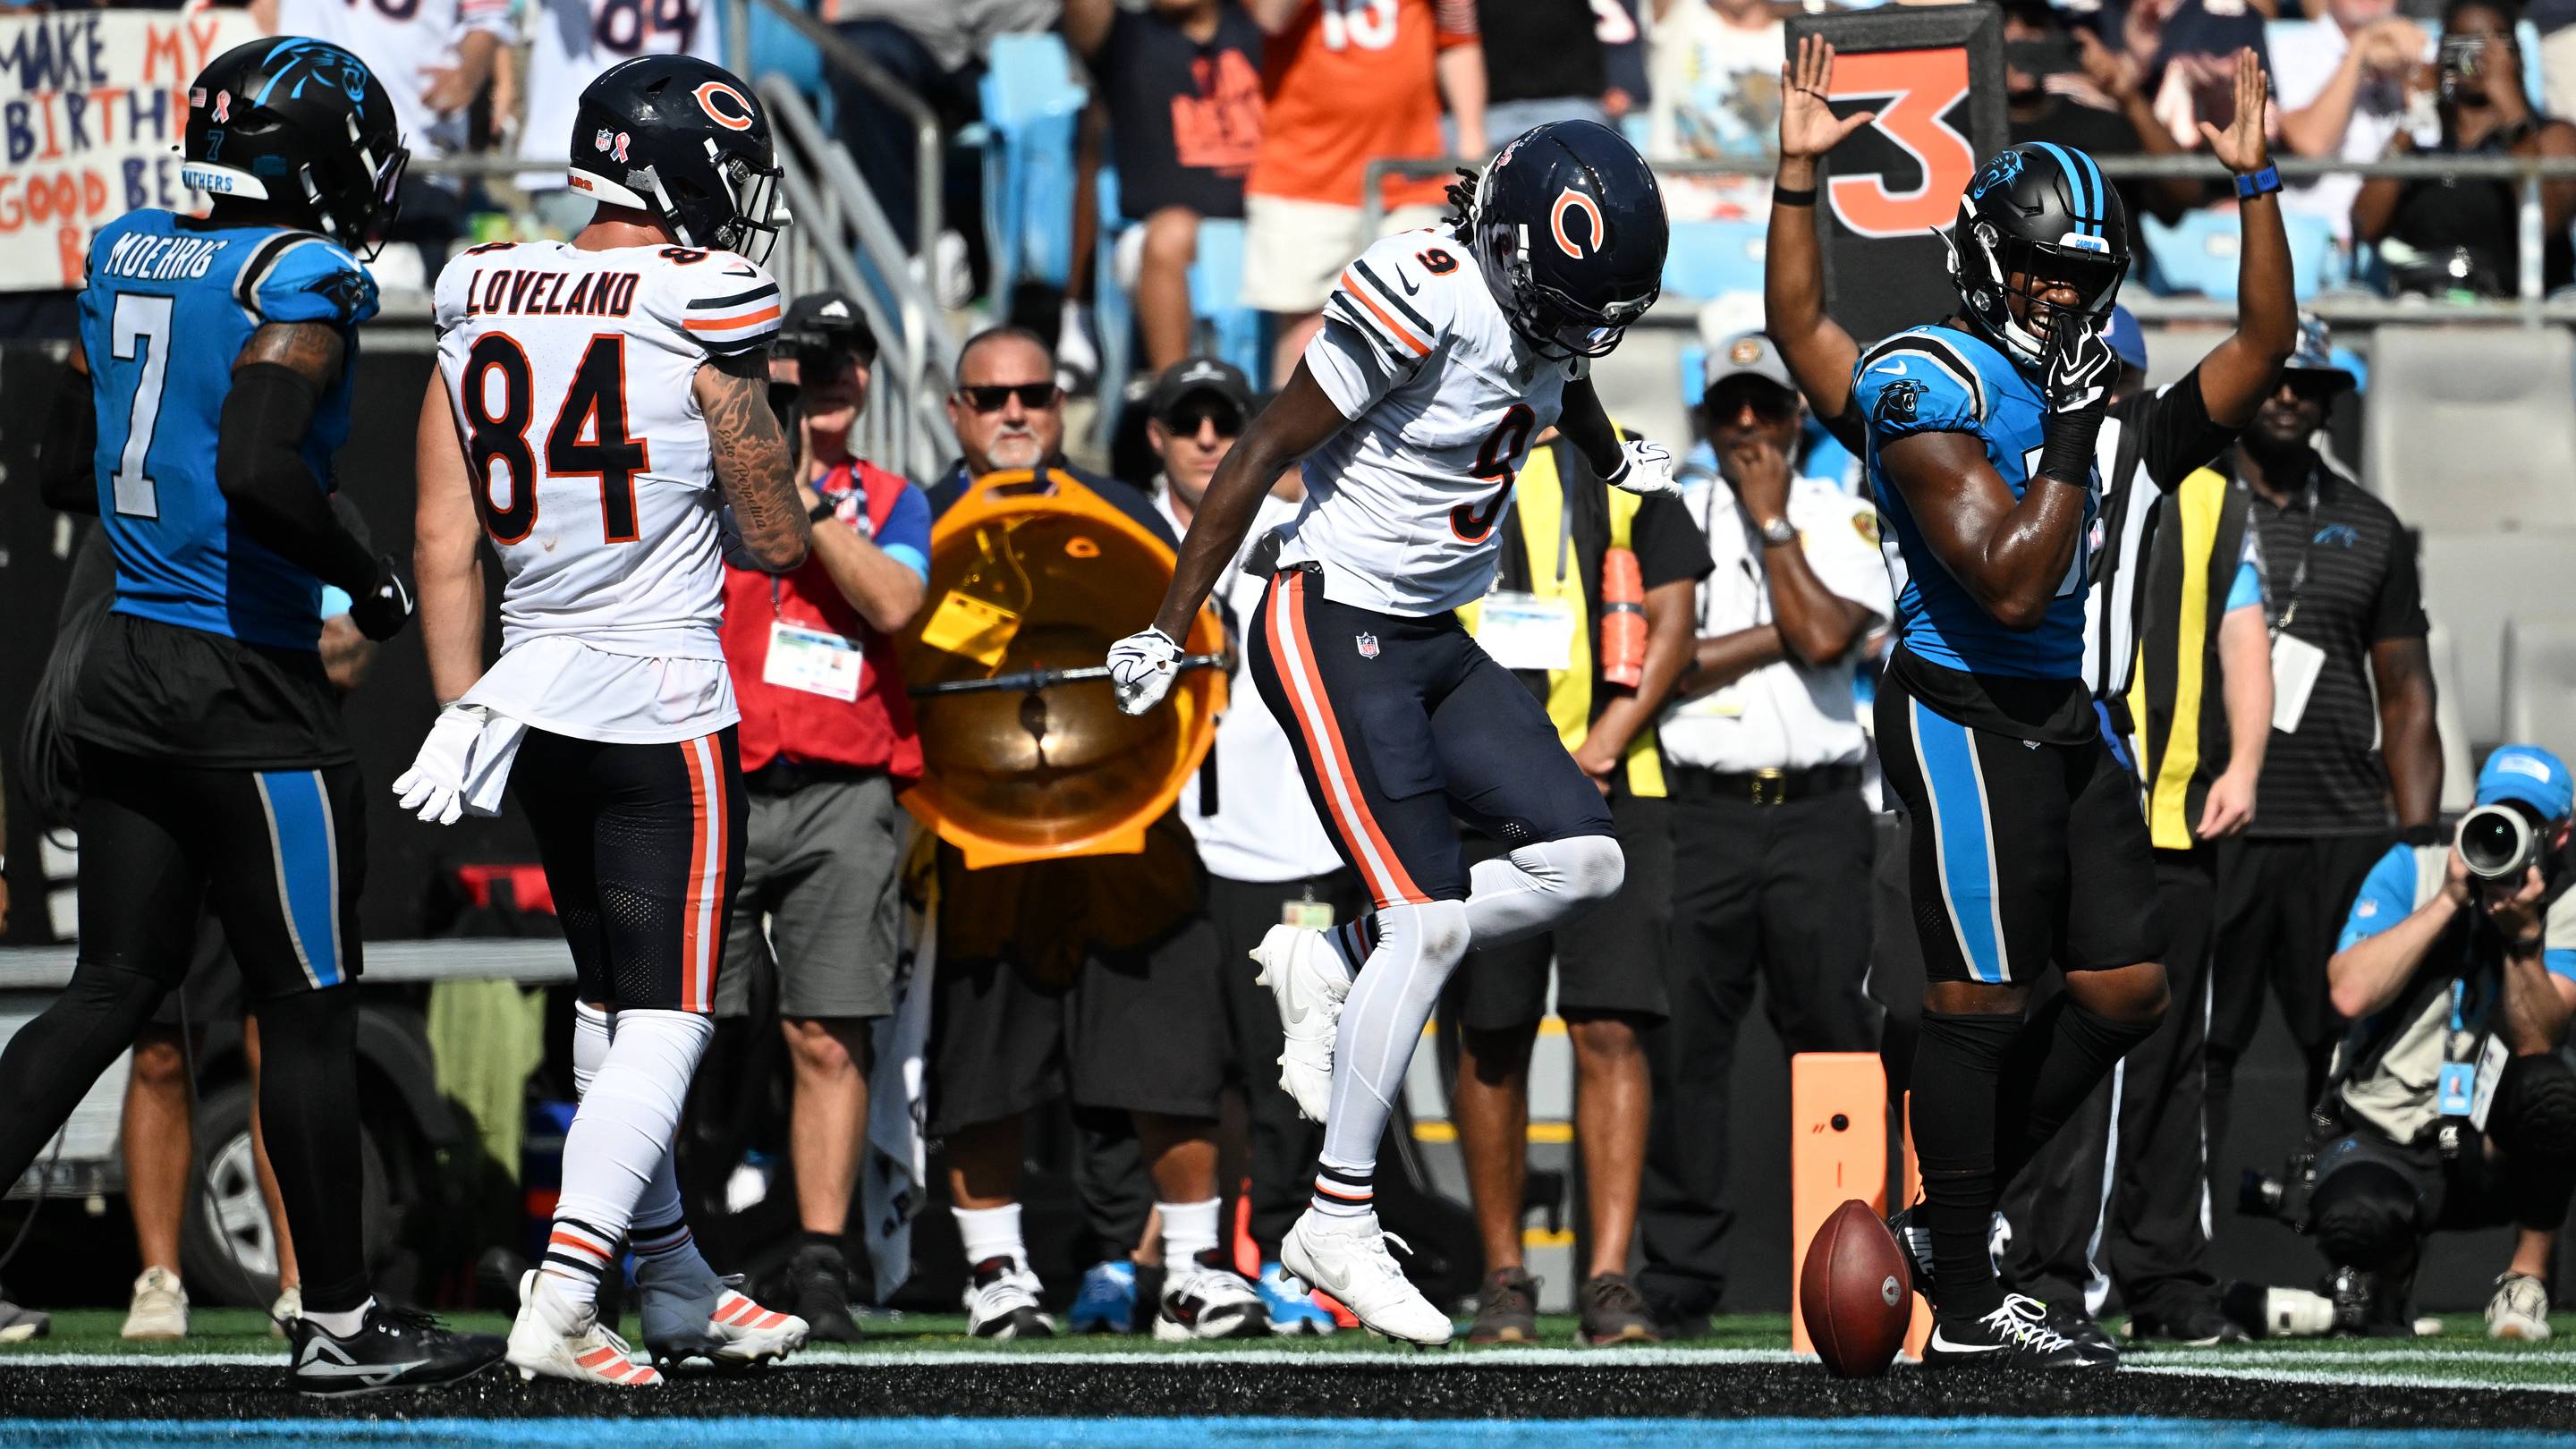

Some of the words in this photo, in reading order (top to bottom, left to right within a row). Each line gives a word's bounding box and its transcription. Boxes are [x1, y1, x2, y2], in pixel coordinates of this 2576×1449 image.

[0, 13, 107, 93] MAKE
[141, 20, 220, 83] MY
[207, 130, 224, 161] 7
[1827, 47, 1975, 239] 3
[0, 165, 108, 234] GOOD
[123, 157, 199, 211] BE
[103, 230, 229, 281] MOEHRIG
[466, 268, 640, 318] LOVELAND
[1415, 248, 1460, 276] 9
[111, 291, 175, 522] 7
[461, 331, 651, 545] 84
[716, 429, 735, 458] Esto
[733, 461, 767, 530] Perpetua
[1449, 403, 1535, 543] 9
